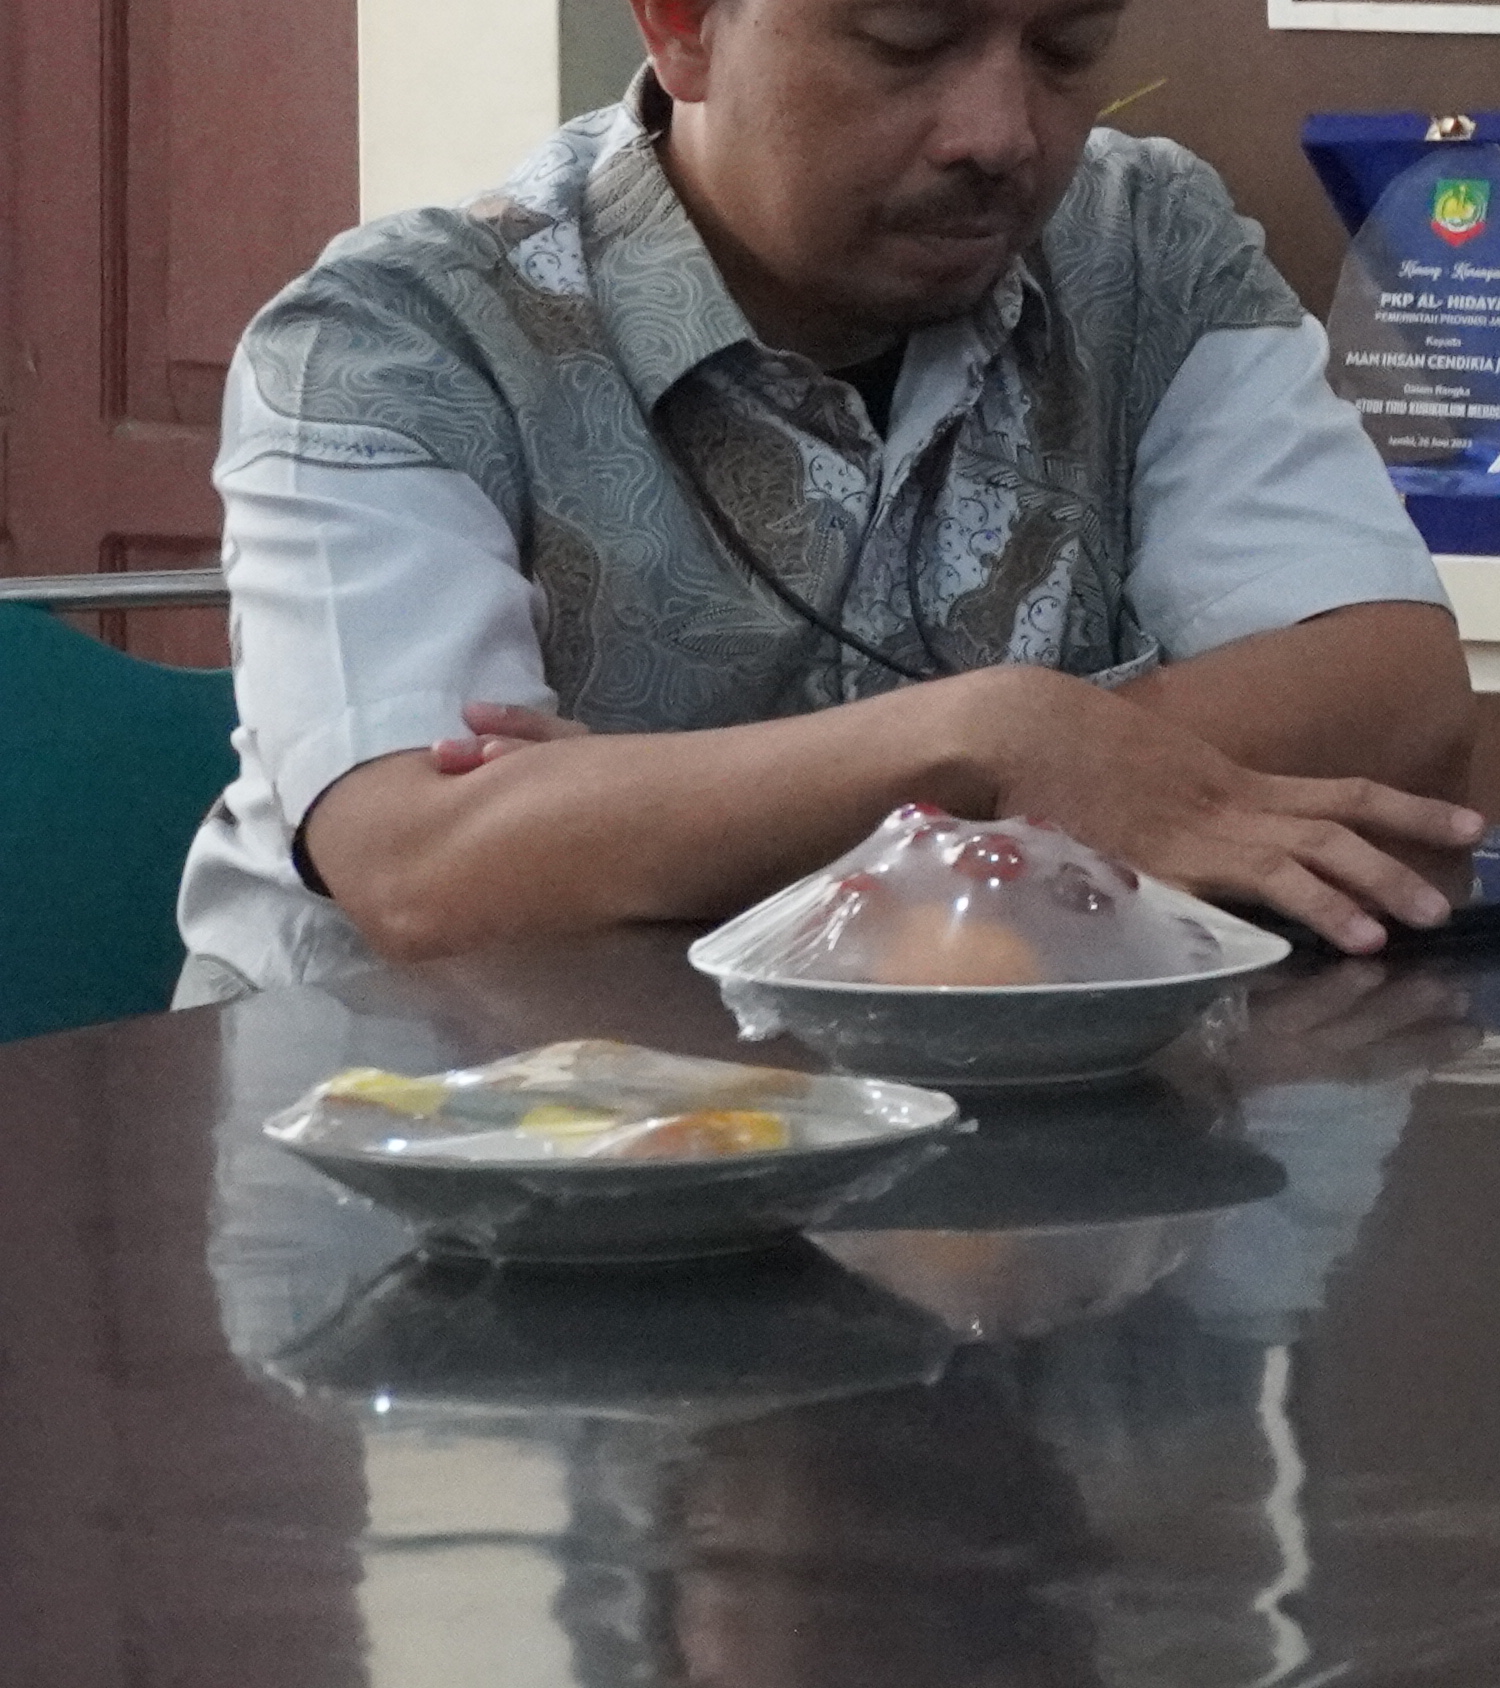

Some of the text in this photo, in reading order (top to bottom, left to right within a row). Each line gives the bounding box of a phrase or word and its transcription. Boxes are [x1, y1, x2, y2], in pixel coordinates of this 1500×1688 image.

[1380, 292, 1414, 308] PKP
[1346, 351, 1380, 367] MAN
[1382, 353, 1426, 369] INSAN
[1427, 355, 1494, 372] CENDIKIA
